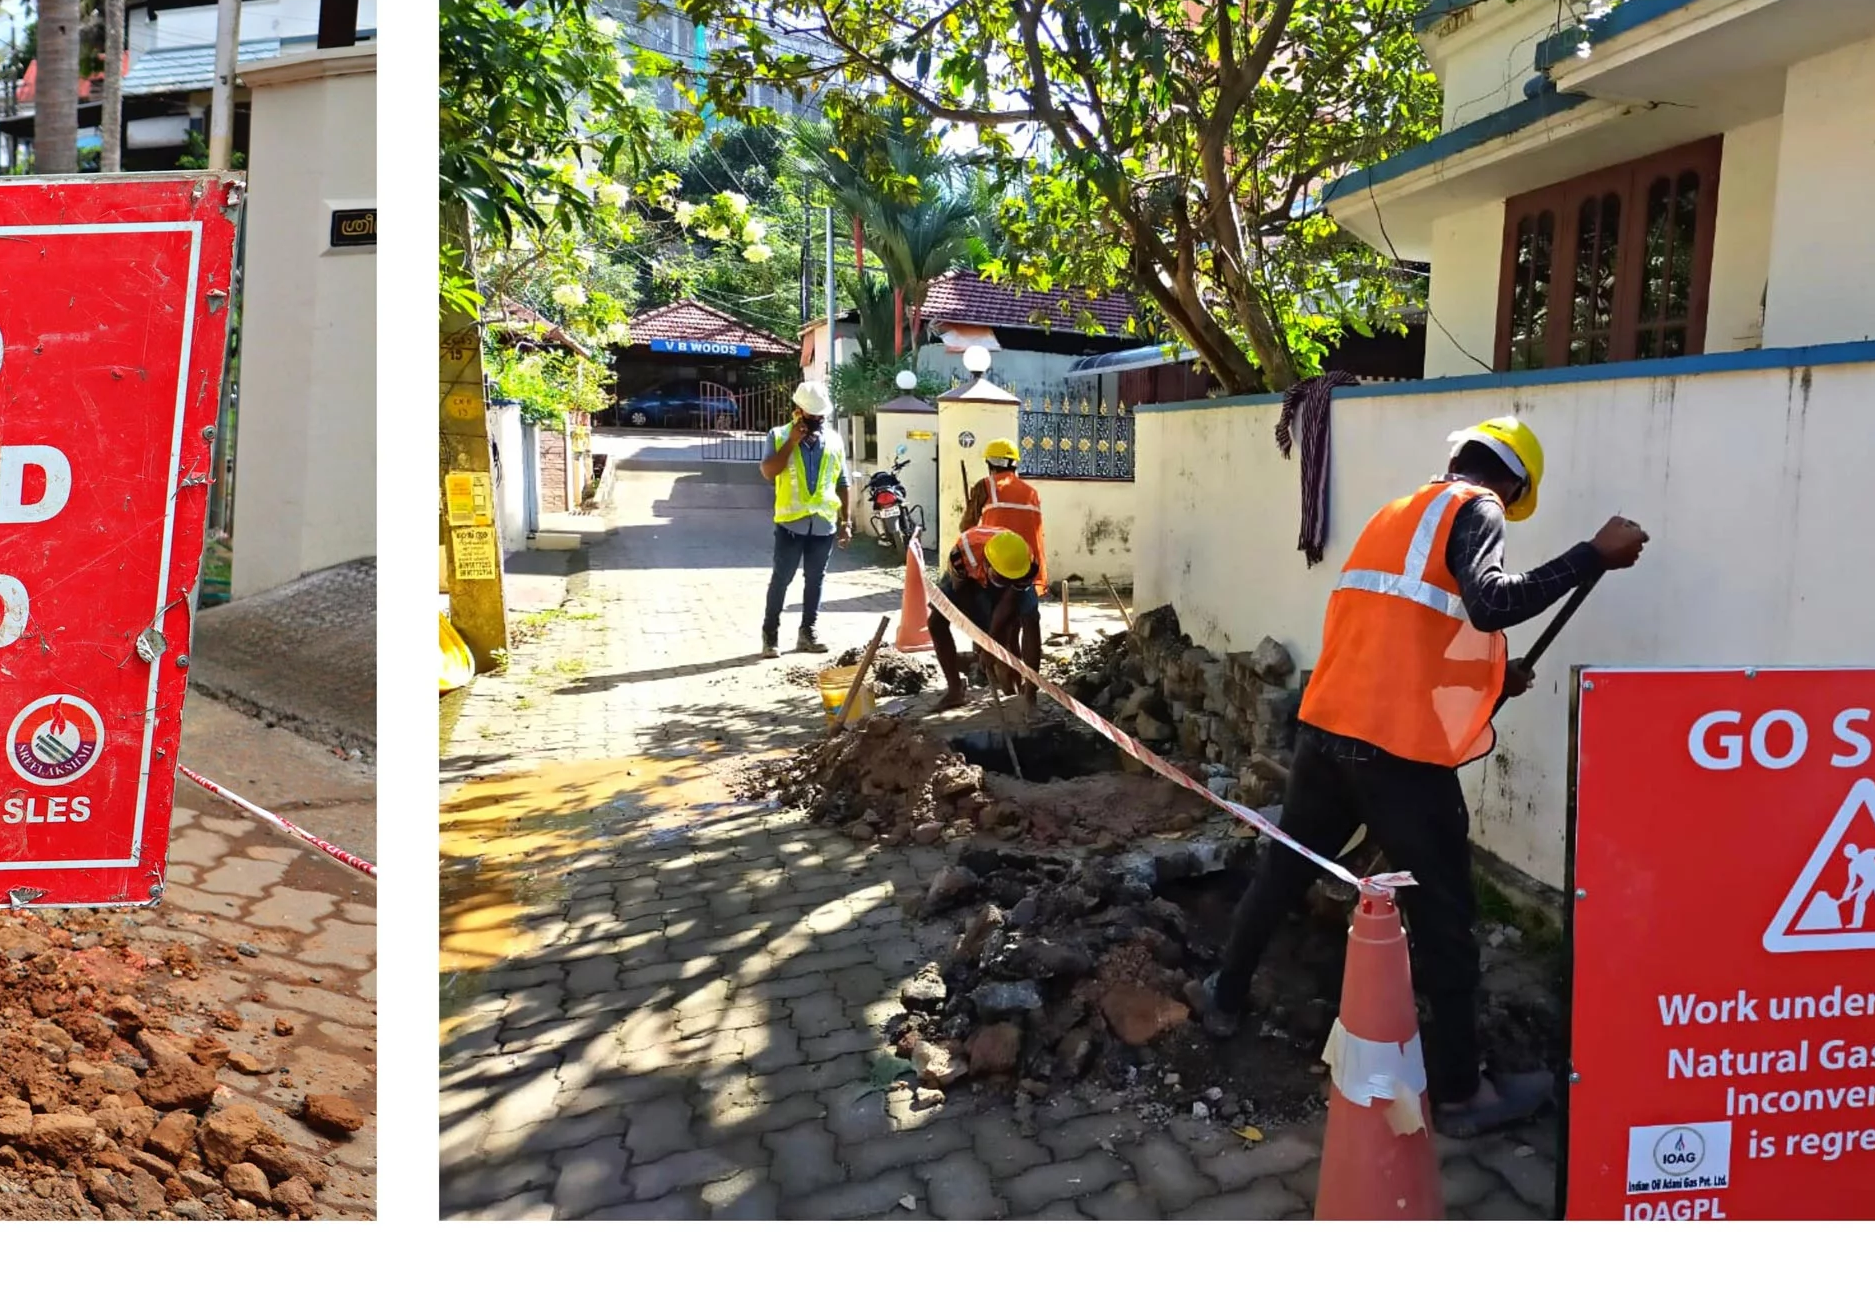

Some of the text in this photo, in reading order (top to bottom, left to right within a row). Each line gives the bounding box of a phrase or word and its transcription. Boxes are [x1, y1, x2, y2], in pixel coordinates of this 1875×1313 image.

[665, 342, 675, 350] V
[691, 344, 737, 354] WOODS
[1689, 710, 1808, 769] GO
[3, 796, 91, 824] SLES
[1659, 991, 1757, 1025] Work
[1669, 1041, 1807, 1078] Natural
[1663, 1152, 1696, 1164] IOAG
[1748, 1129, 1775, 1160] is
[1629, 1174, 1727, 1192] Indian Oil Adani Gas Pvt. Ltd.
[1623, 1197, 1727, 1221] IOAGPL
